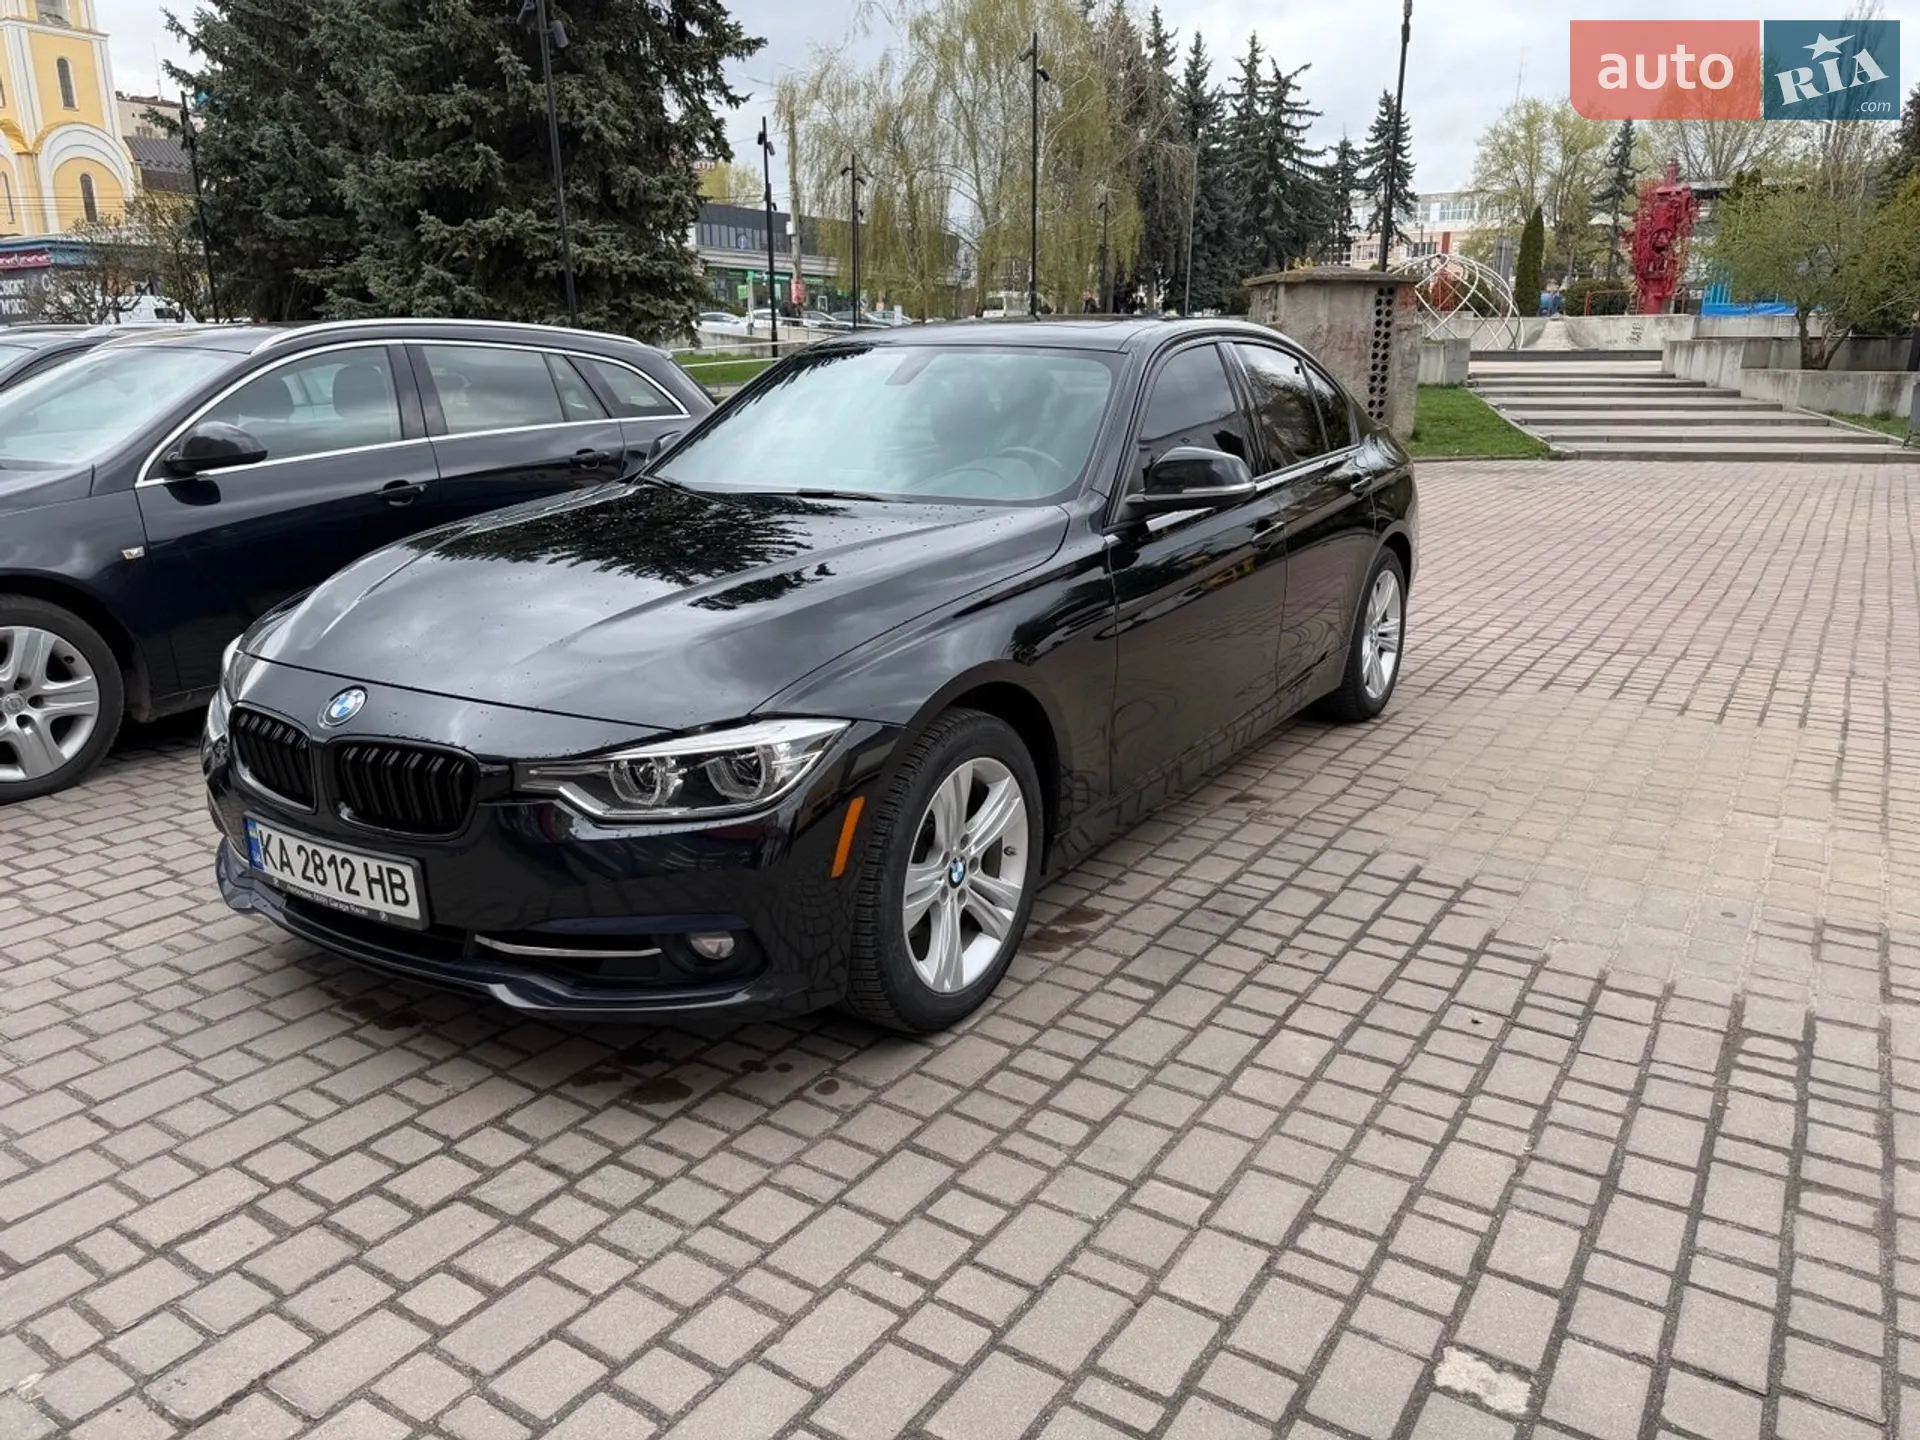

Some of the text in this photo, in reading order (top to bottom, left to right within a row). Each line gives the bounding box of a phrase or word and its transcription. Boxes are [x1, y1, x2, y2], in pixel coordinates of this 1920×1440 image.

[259, 830, 295, 877] KA
[297, 845, 360, 896] 2812
[364, 861, 410, 907] HB
